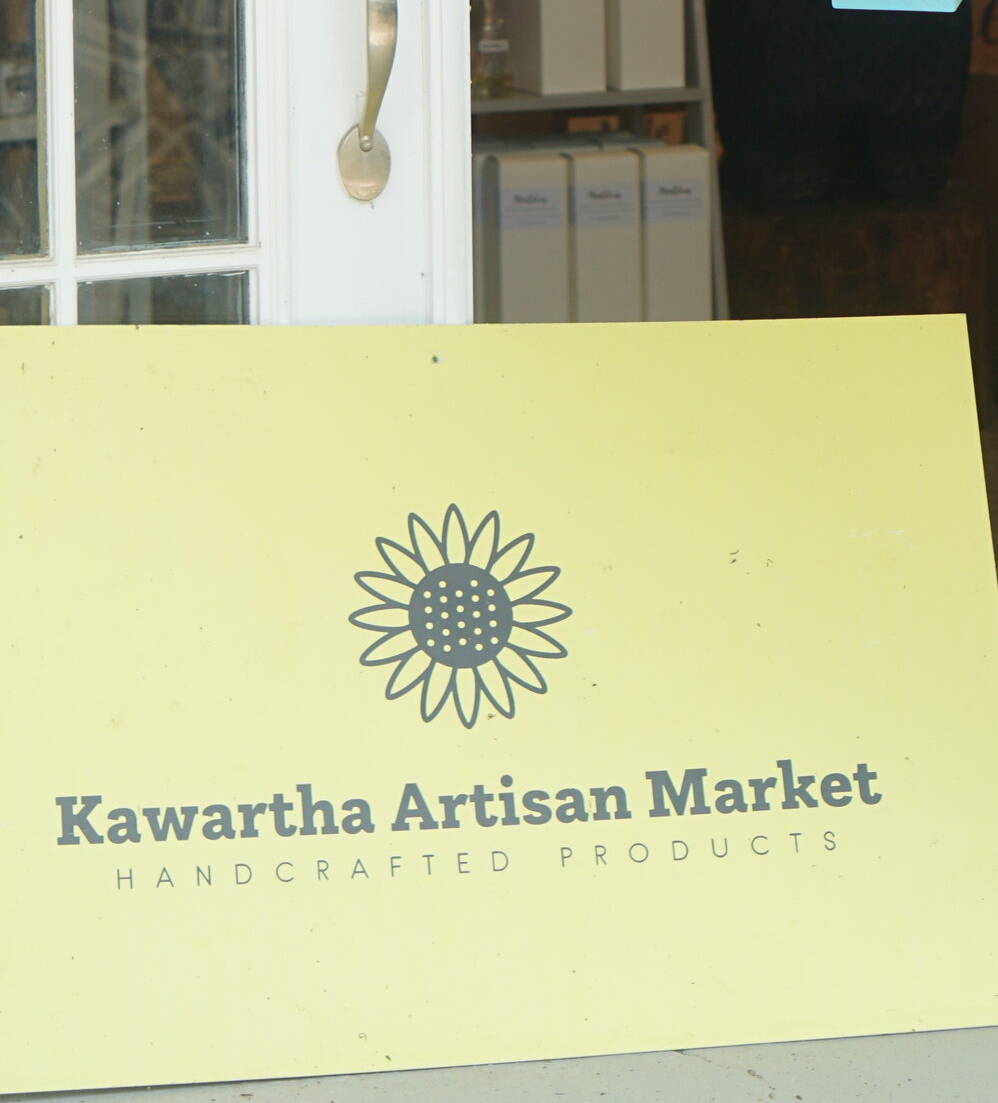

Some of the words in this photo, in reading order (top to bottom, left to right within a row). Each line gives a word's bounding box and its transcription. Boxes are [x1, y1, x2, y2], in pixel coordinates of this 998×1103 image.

[56, 784, 375, 845] Kawartha
[391, 775, 632, 831] Artisan
[645, 759, 882, 817] Market
[116, 850, 509, 890] HANDCRAFTED
[560, 830, 837, 868] PRODUCTS
